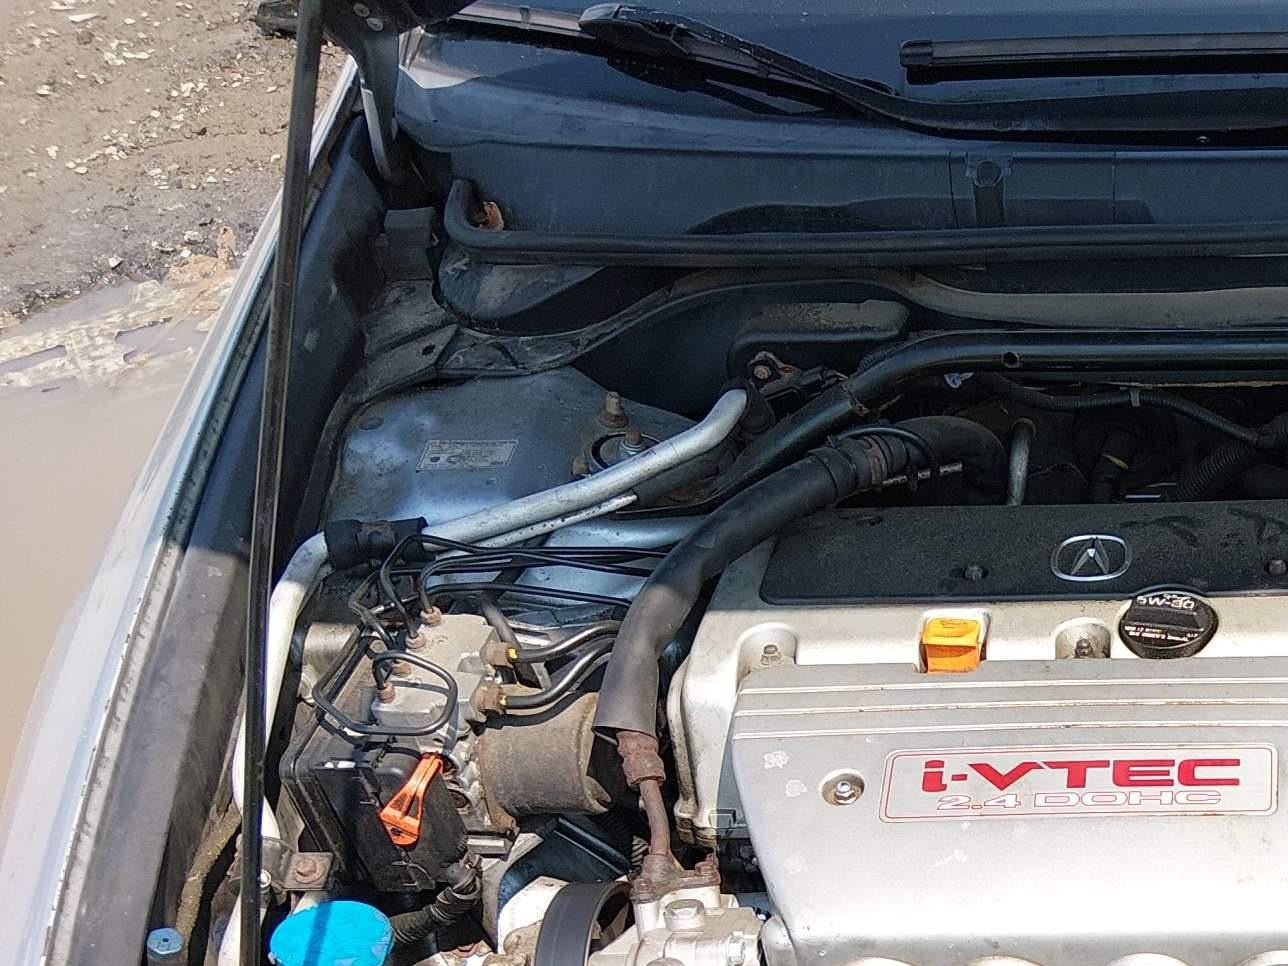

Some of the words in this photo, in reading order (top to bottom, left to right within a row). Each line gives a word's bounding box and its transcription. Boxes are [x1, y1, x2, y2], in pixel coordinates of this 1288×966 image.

[921, 758, 1241, 793] i-VTEC
[936, 792, 1021, 810] 2.4
[1033, 790, 1222, 808] DOHC
